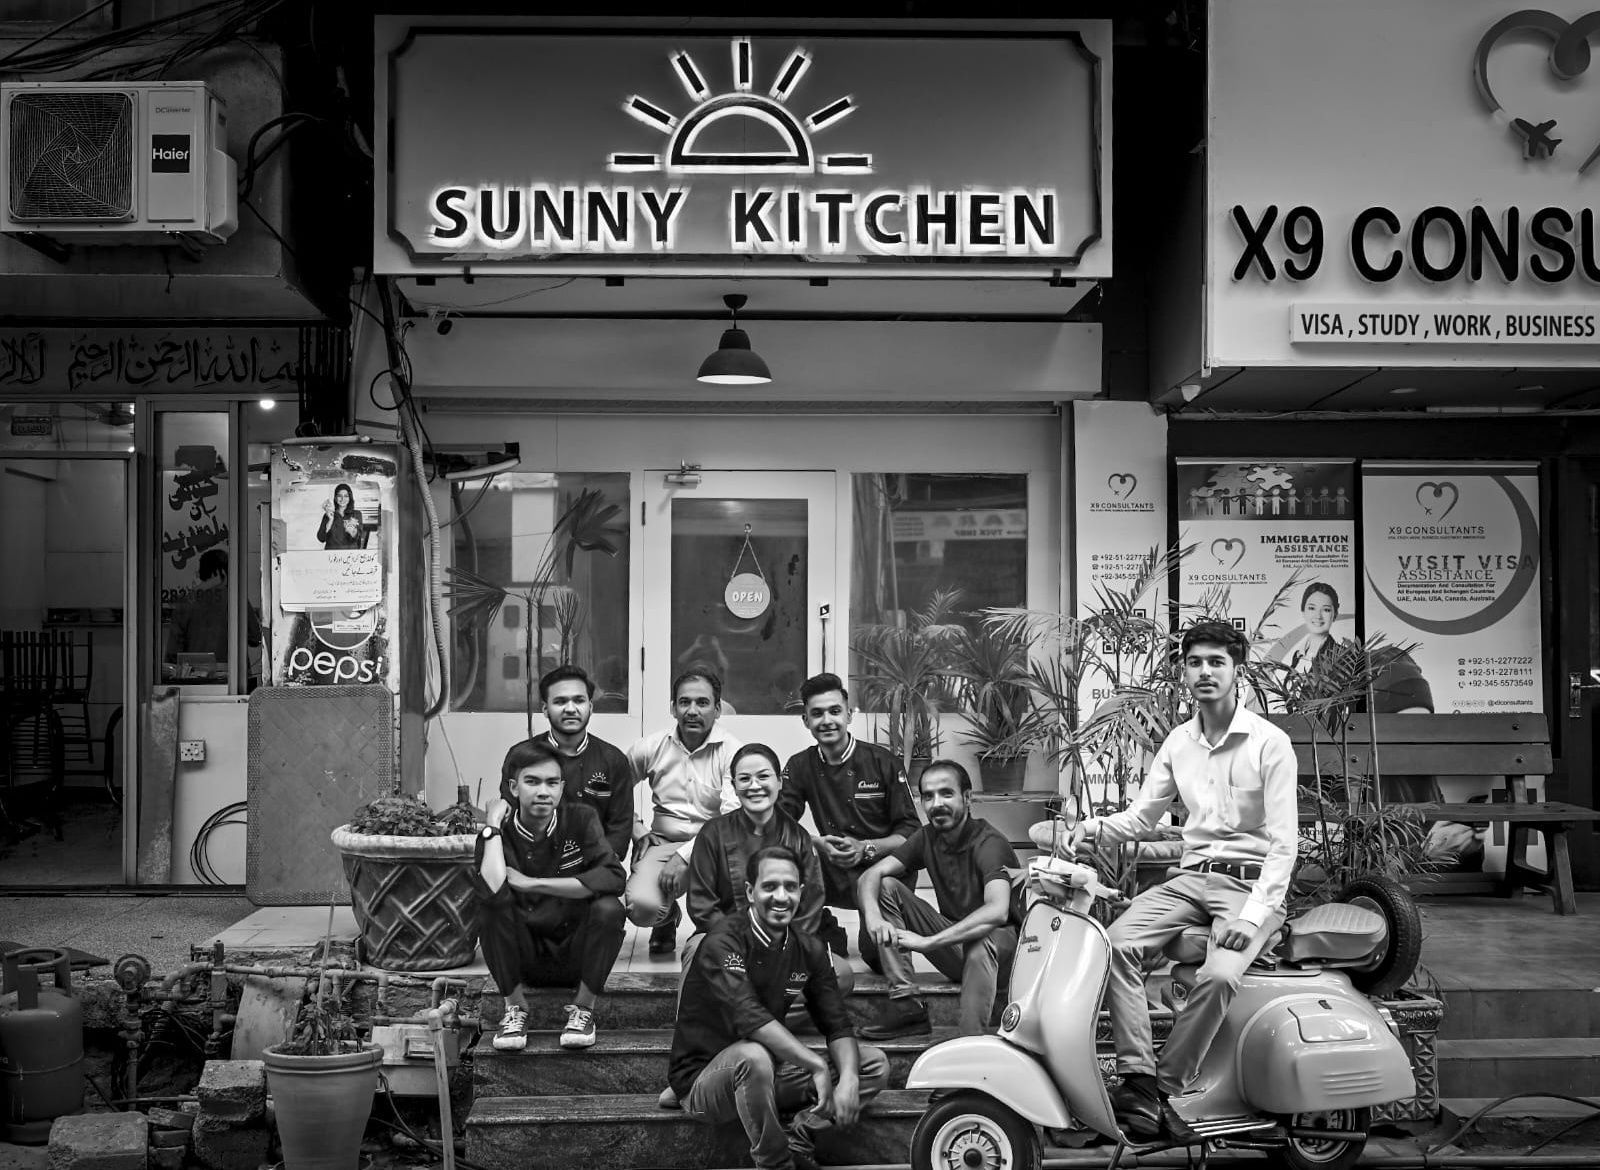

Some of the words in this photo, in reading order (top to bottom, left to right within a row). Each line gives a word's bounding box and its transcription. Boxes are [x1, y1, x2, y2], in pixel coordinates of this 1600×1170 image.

[152, 147, 189, 160] Haier
[431, 188, 684, 246] SUNNY
[734, 190, 1055, 247] KITCHEN
[1232, 205, 1324, 281] X9
[1506, 315, 1595, 337] BUSINESS
[1389, 526, 1402, 535] X9
[1405, 526, 1485, 535] CONSULTANTS
[1260, 535, 1349, 544] IMMIGRATION
[1275, 544, 1349, 552] ASSISTANCE
[1398, 555, 1465, 570] VISIT
[1478, 555, 1535, 570] VISA
[1398, 570, 1493, 581] ASSISTANCE
[732, 591, 763, 602] OPEN
[288, 647, 383, 684] pepsi
[1468, 668, 1533, 676] +92-51-2278111
